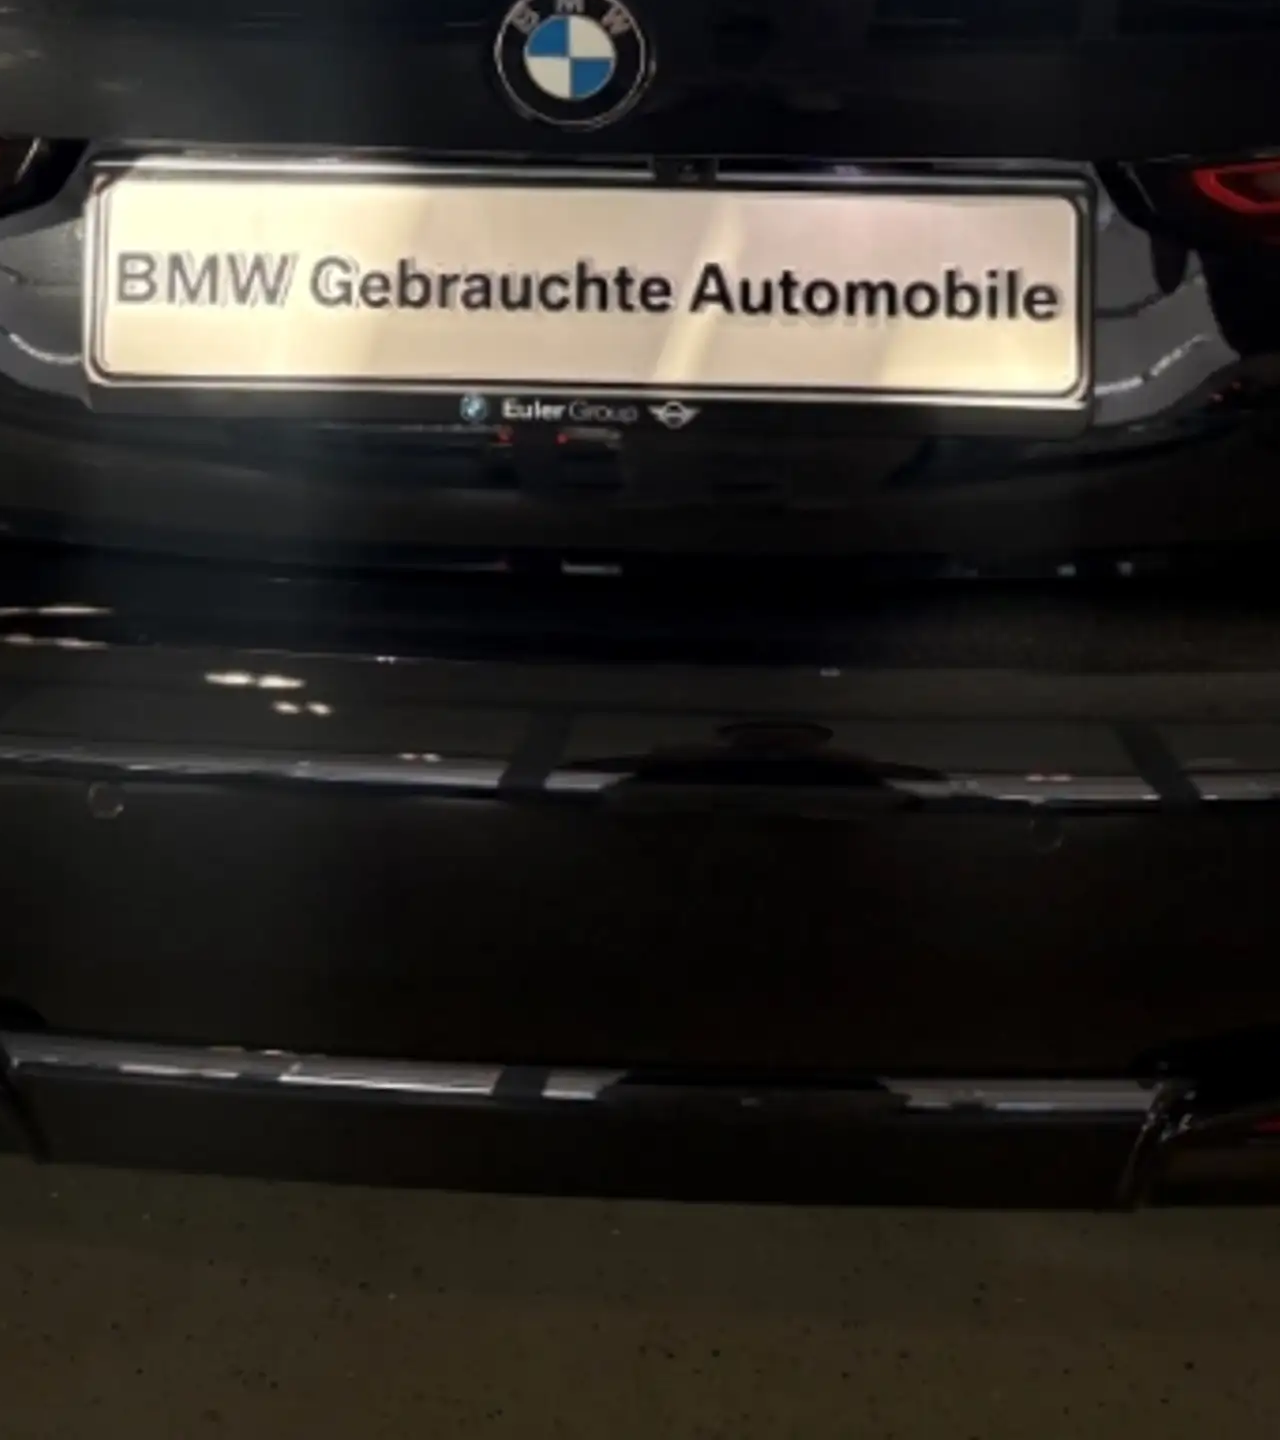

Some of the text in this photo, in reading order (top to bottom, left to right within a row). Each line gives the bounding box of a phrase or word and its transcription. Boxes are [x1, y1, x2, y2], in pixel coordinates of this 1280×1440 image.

[116, 251, 1060, 321] BMW Gebrauchte Automobile
